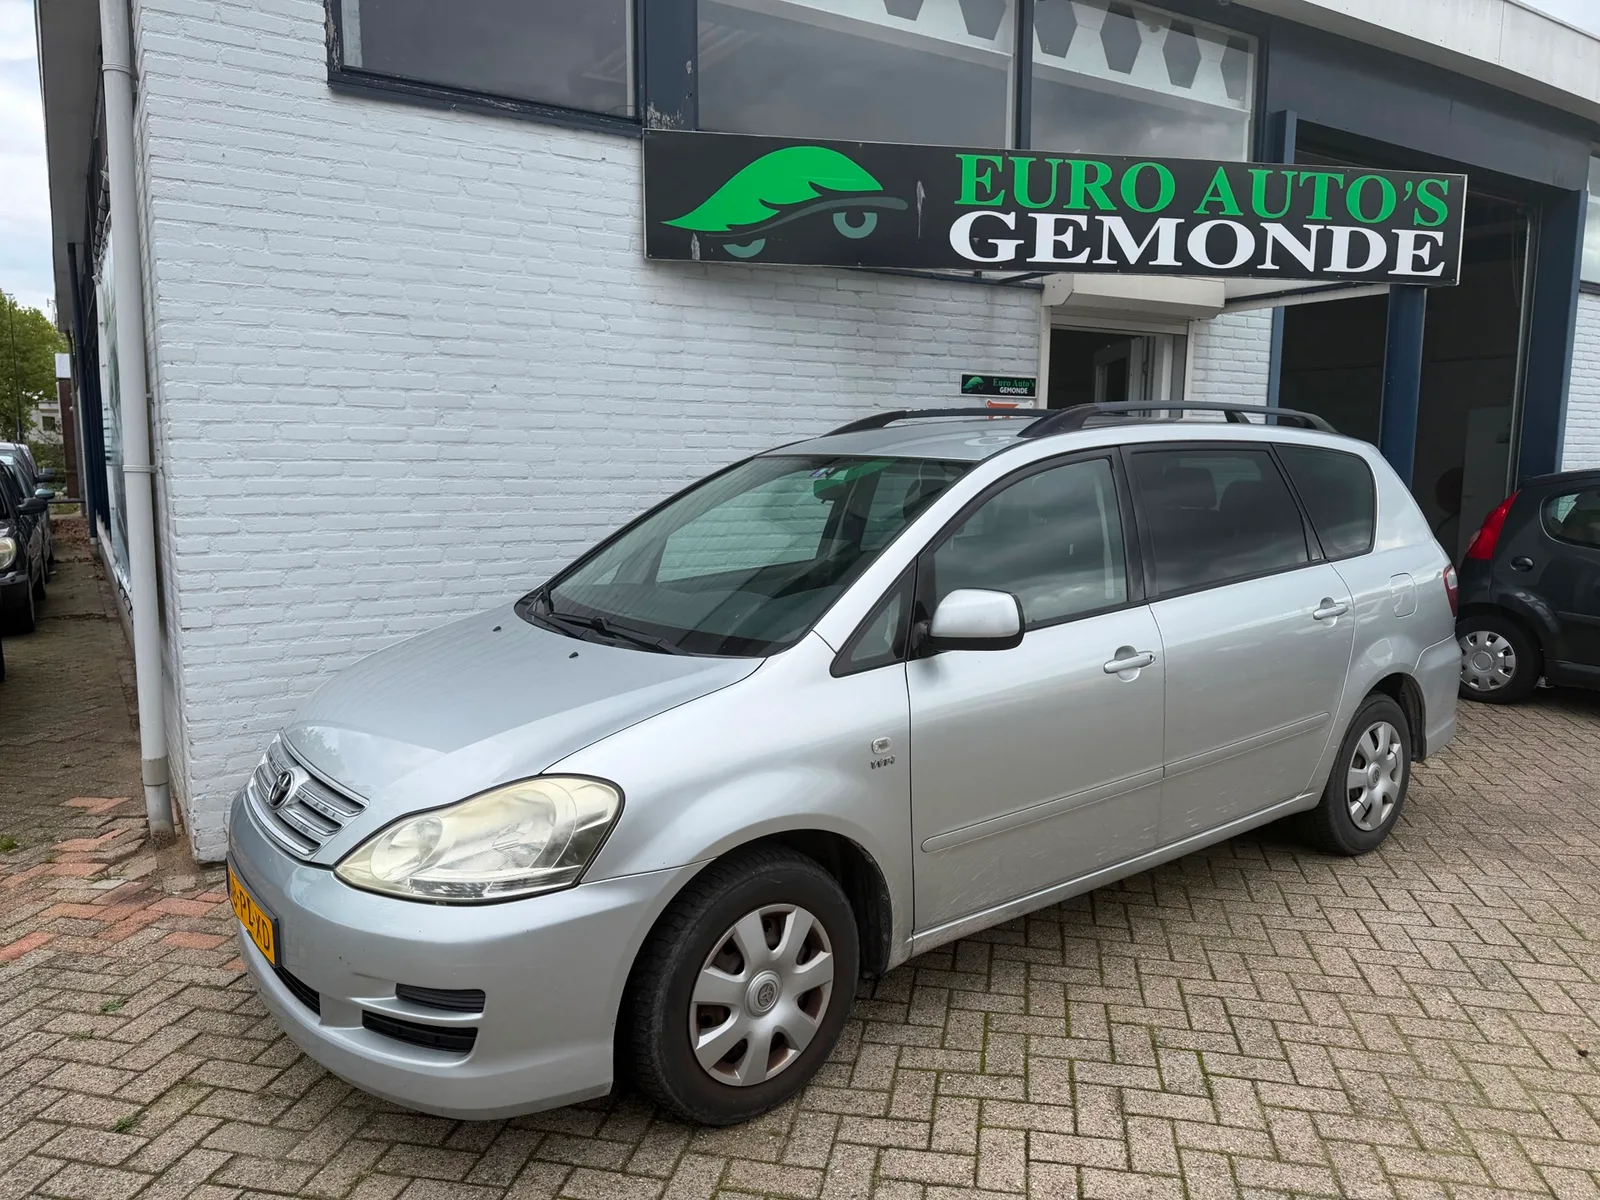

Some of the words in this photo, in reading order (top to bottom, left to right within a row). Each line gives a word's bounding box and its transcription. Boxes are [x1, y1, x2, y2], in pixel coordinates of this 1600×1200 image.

[954, 153, 1177, 214] EURO
[1192, 166, 1450, 228] AUTO'S
[949, 210, 1446, 277] GEMONDE
[992, 378, 1012, 387] Euro
[999, 386, 1028, 395] GEMONDE
